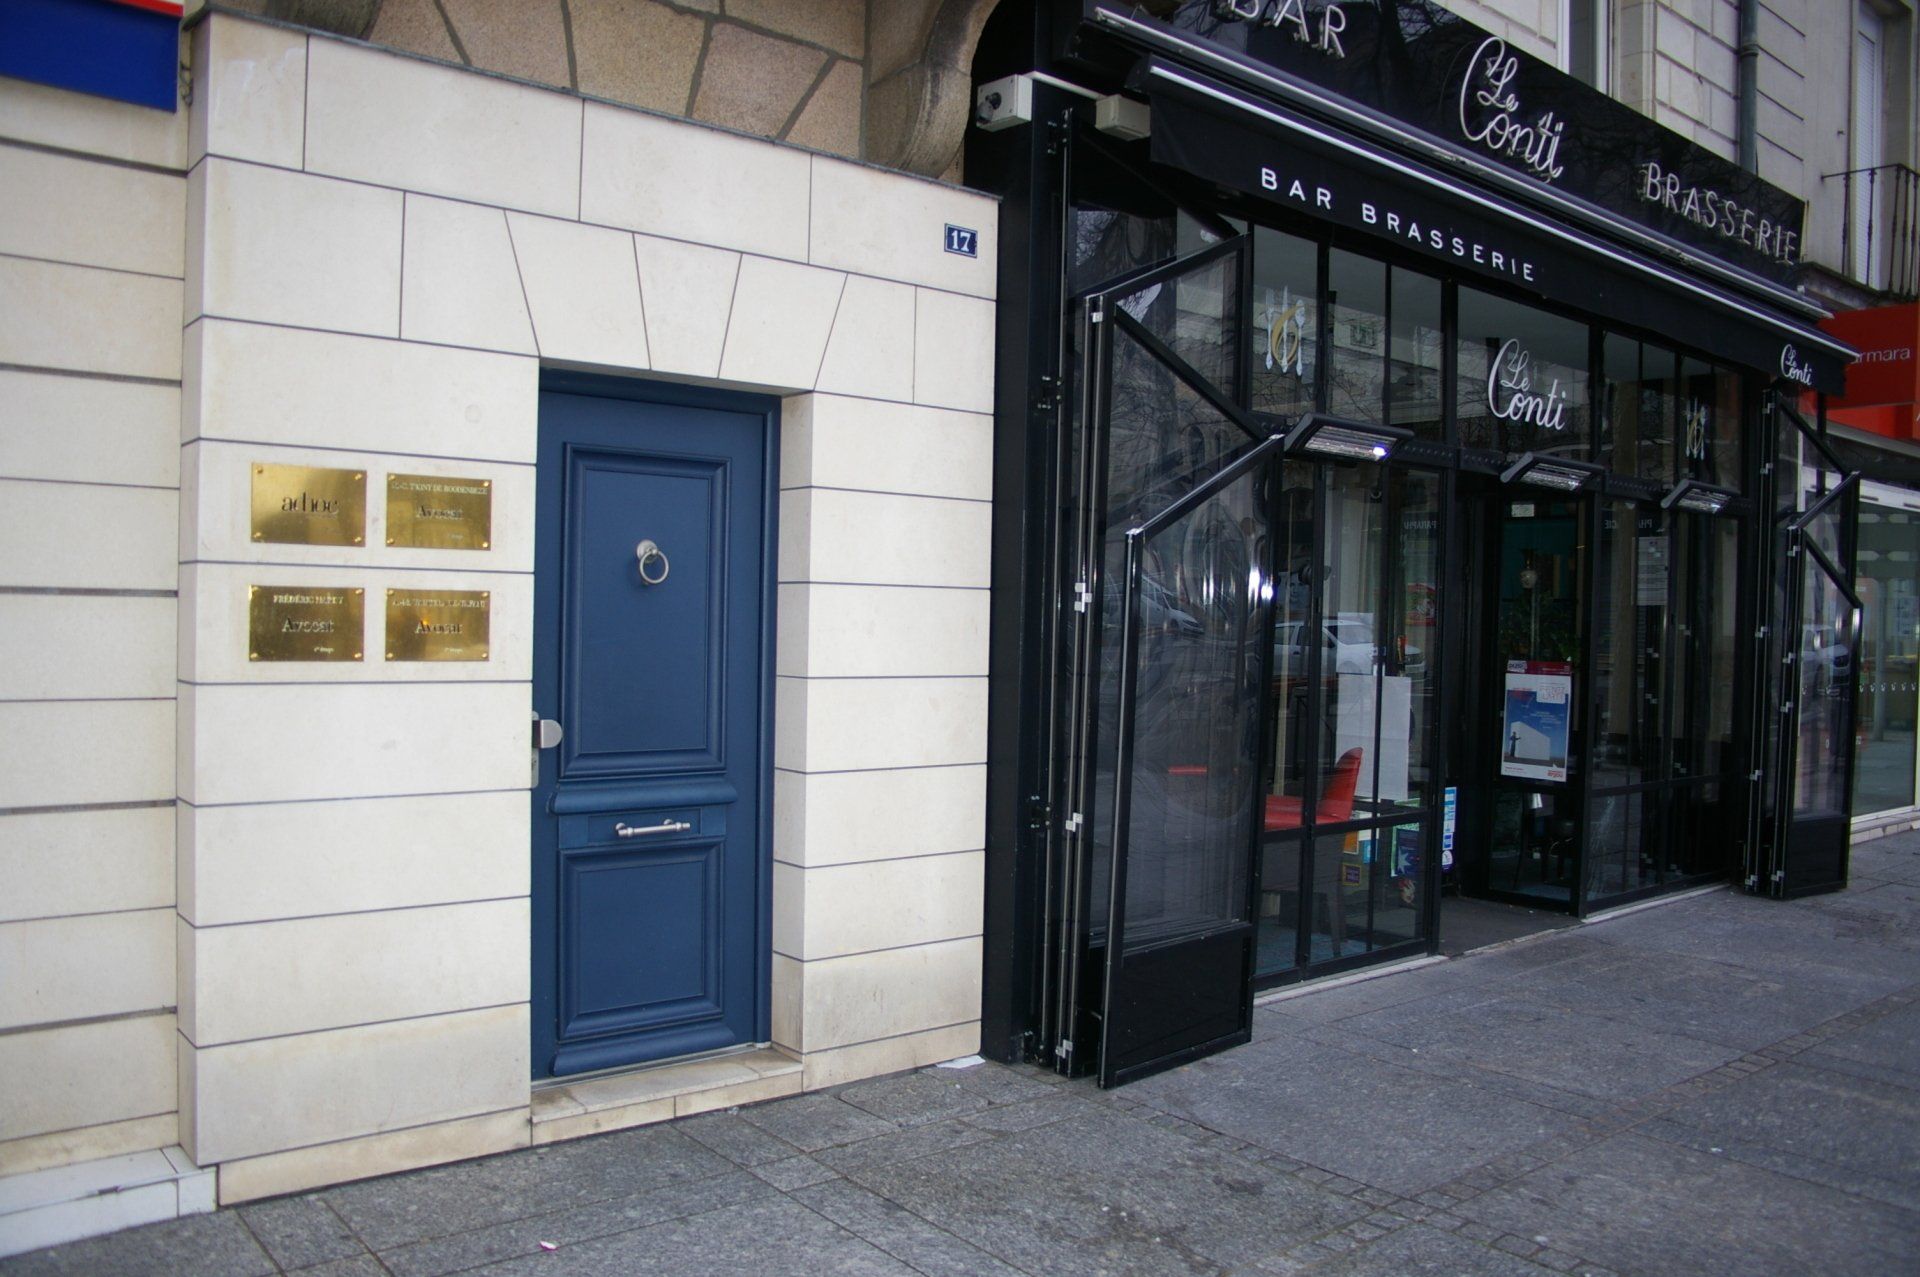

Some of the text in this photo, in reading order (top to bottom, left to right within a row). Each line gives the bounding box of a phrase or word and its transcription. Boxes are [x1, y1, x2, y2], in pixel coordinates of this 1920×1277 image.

[1461, 36, 1565, 181] Conti
[1477, 57, 1519, 113] Le
[951, 229, 971, 252] 17
[1260, 166, 1535, 282] BAR BRASSERIE
[1643, 161, 1798, 266] BRASSERIE
[1488, 338, 1566, 431] Conti
[1500, 350, 1530, 391] Le
[1780, 343, 1813, 386] Conti
